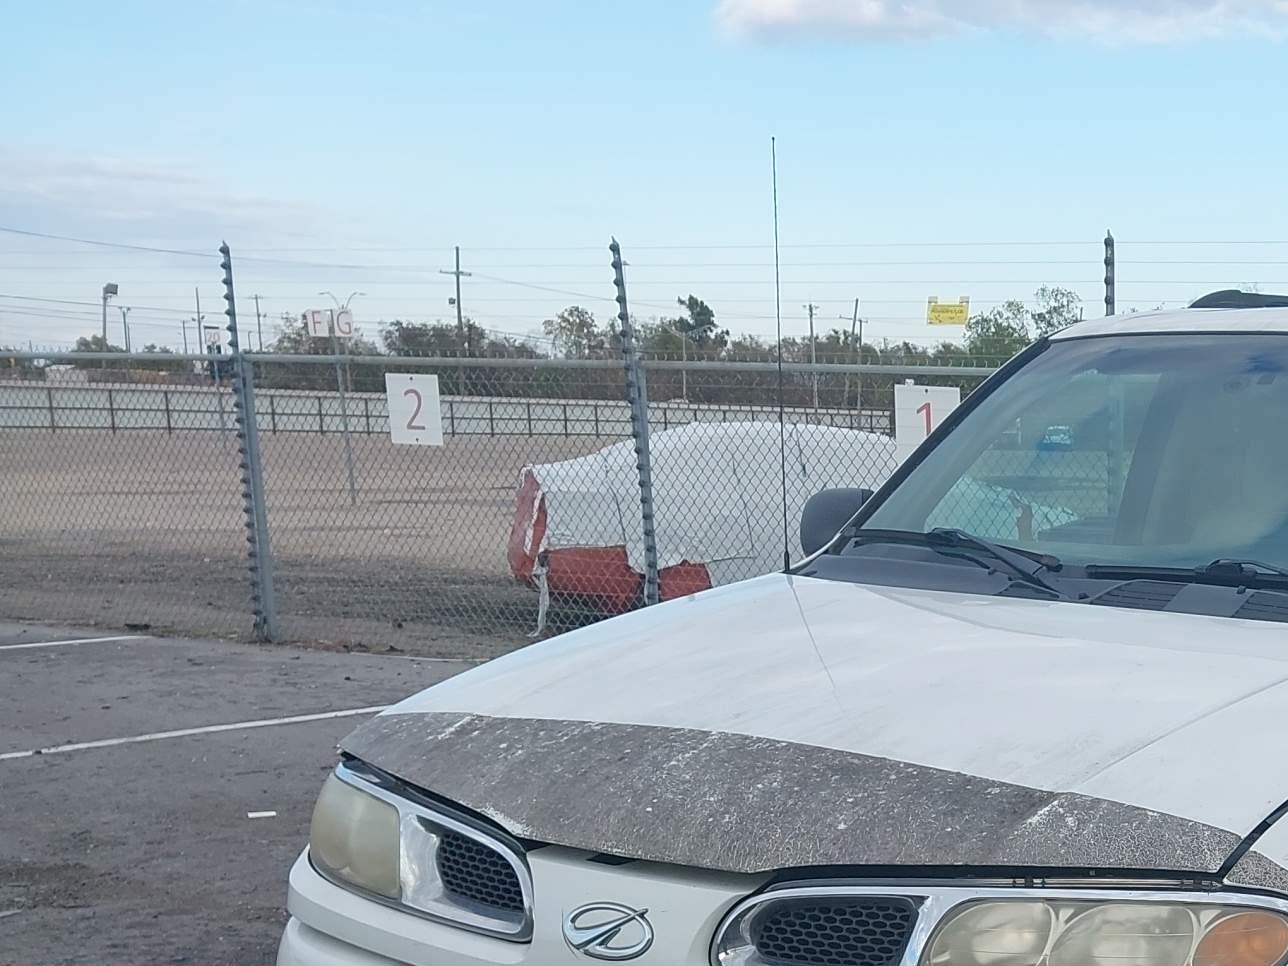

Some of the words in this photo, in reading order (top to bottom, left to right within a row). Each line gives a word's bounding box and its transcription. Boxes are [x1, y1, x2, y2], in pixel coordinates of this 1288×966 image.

[312, 310, 322, 335] F
[336, 311, 352, 335] G
[403, 388, 426, 431] 2
[916, 402, 932, 436] 1
